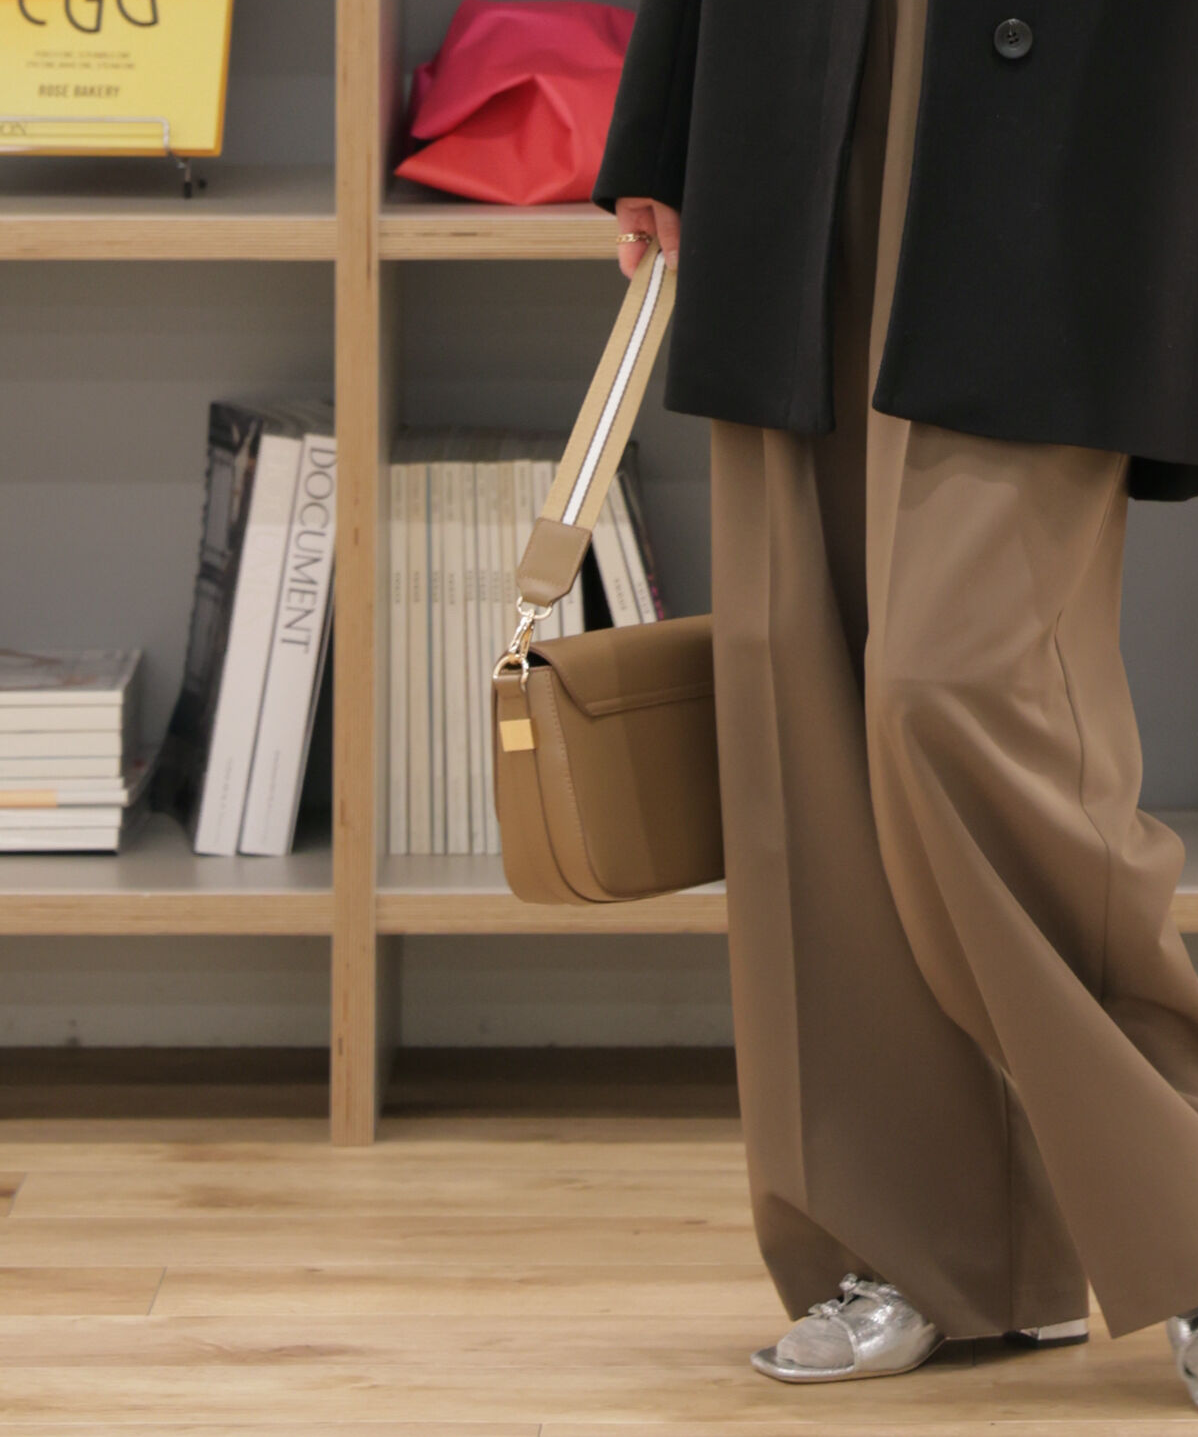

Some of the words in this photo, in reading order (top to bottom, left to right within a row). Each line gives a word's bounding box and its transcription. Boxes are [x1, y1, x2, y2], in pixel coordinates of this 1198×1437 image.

[39, 84, 68, 98] ROSE
[74, 84, 120, 98] BAKERY
[280, 446, 337, 654] DOCUMENT
